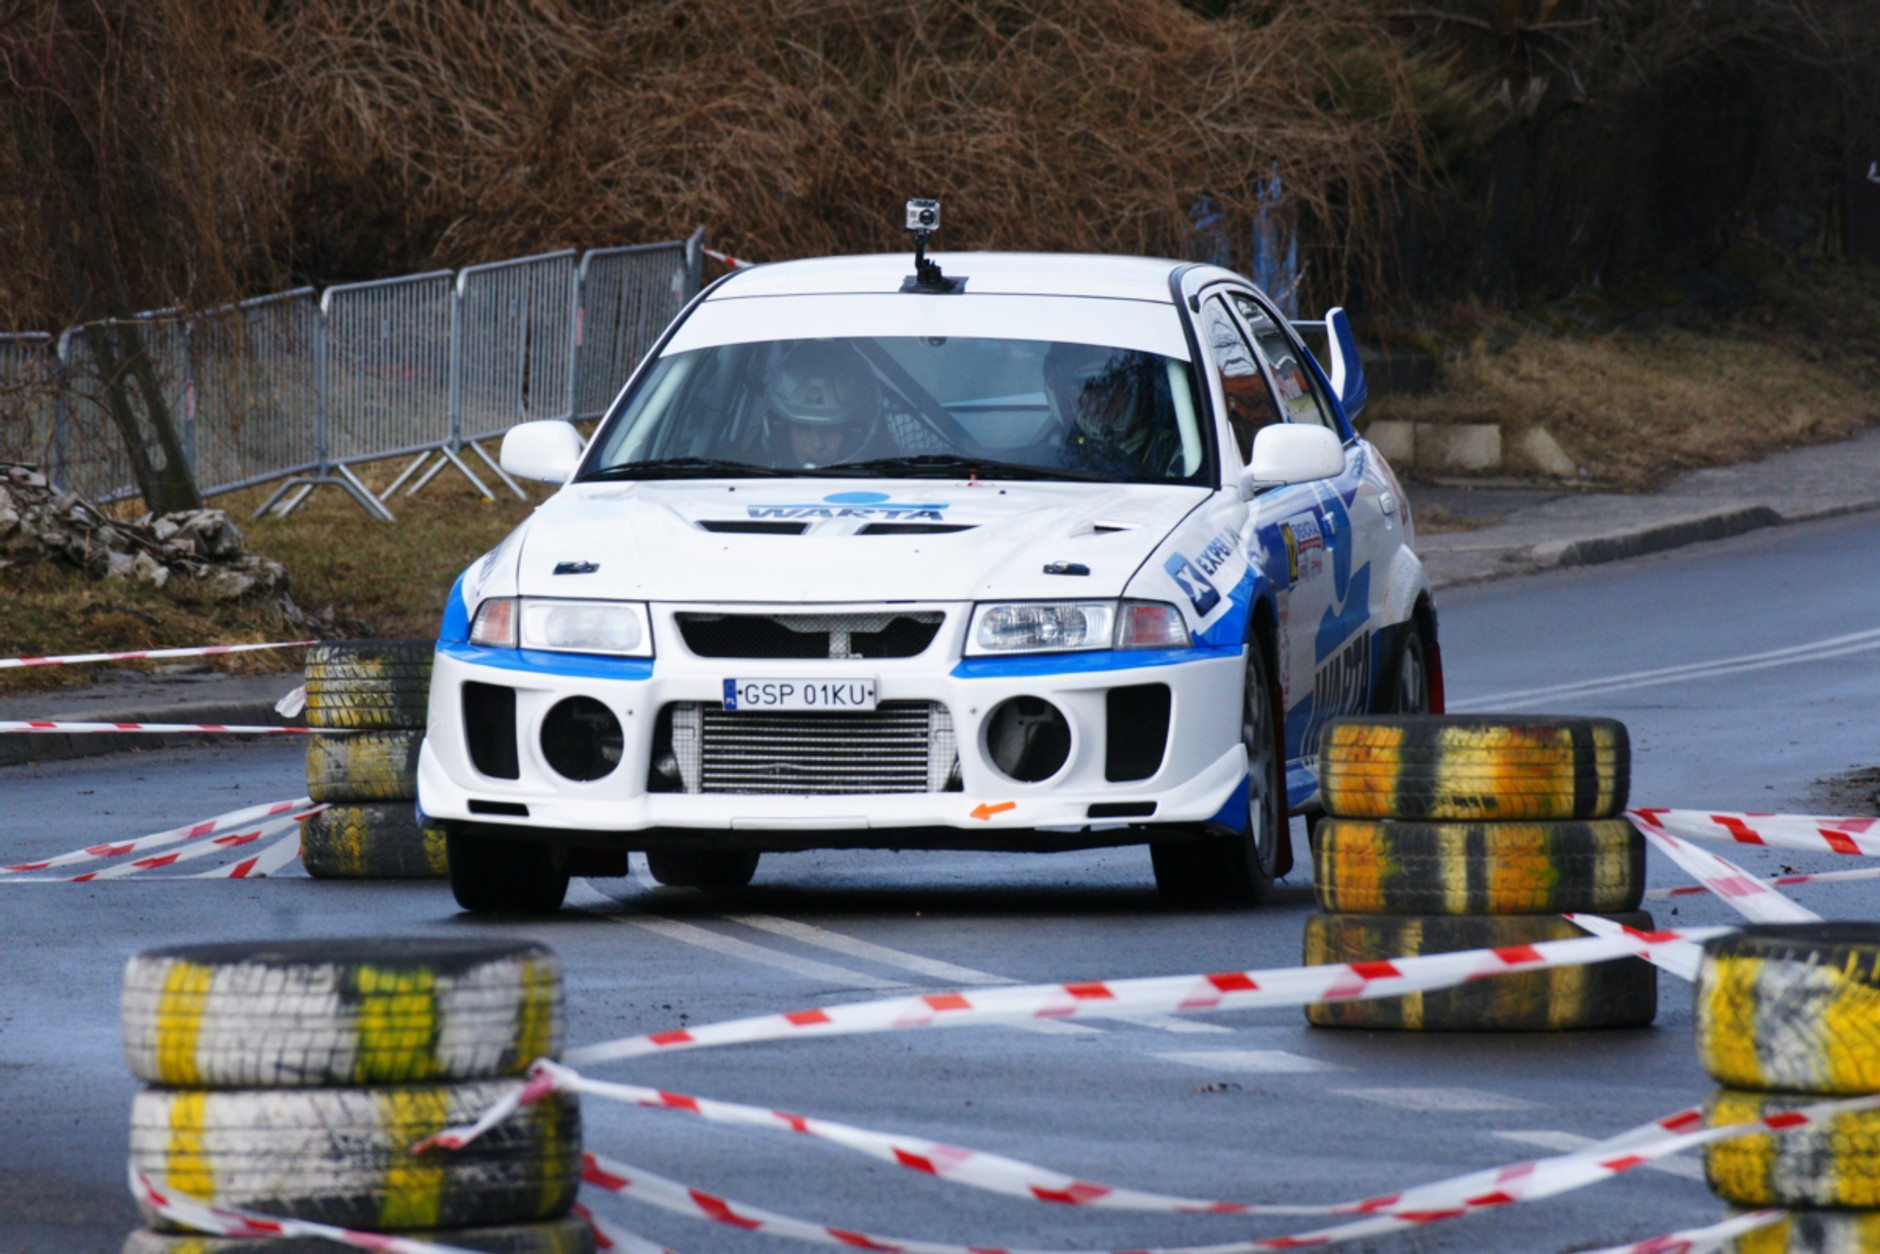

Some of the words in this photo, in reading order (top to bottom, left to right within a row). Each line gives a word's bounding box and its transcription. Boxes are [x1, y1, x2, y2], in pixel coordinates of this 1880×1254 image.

[747, 507, 944, 521] WARTA
[744, 683, 795, 705] GSP
[803, 683, 866, 705] 01KU
